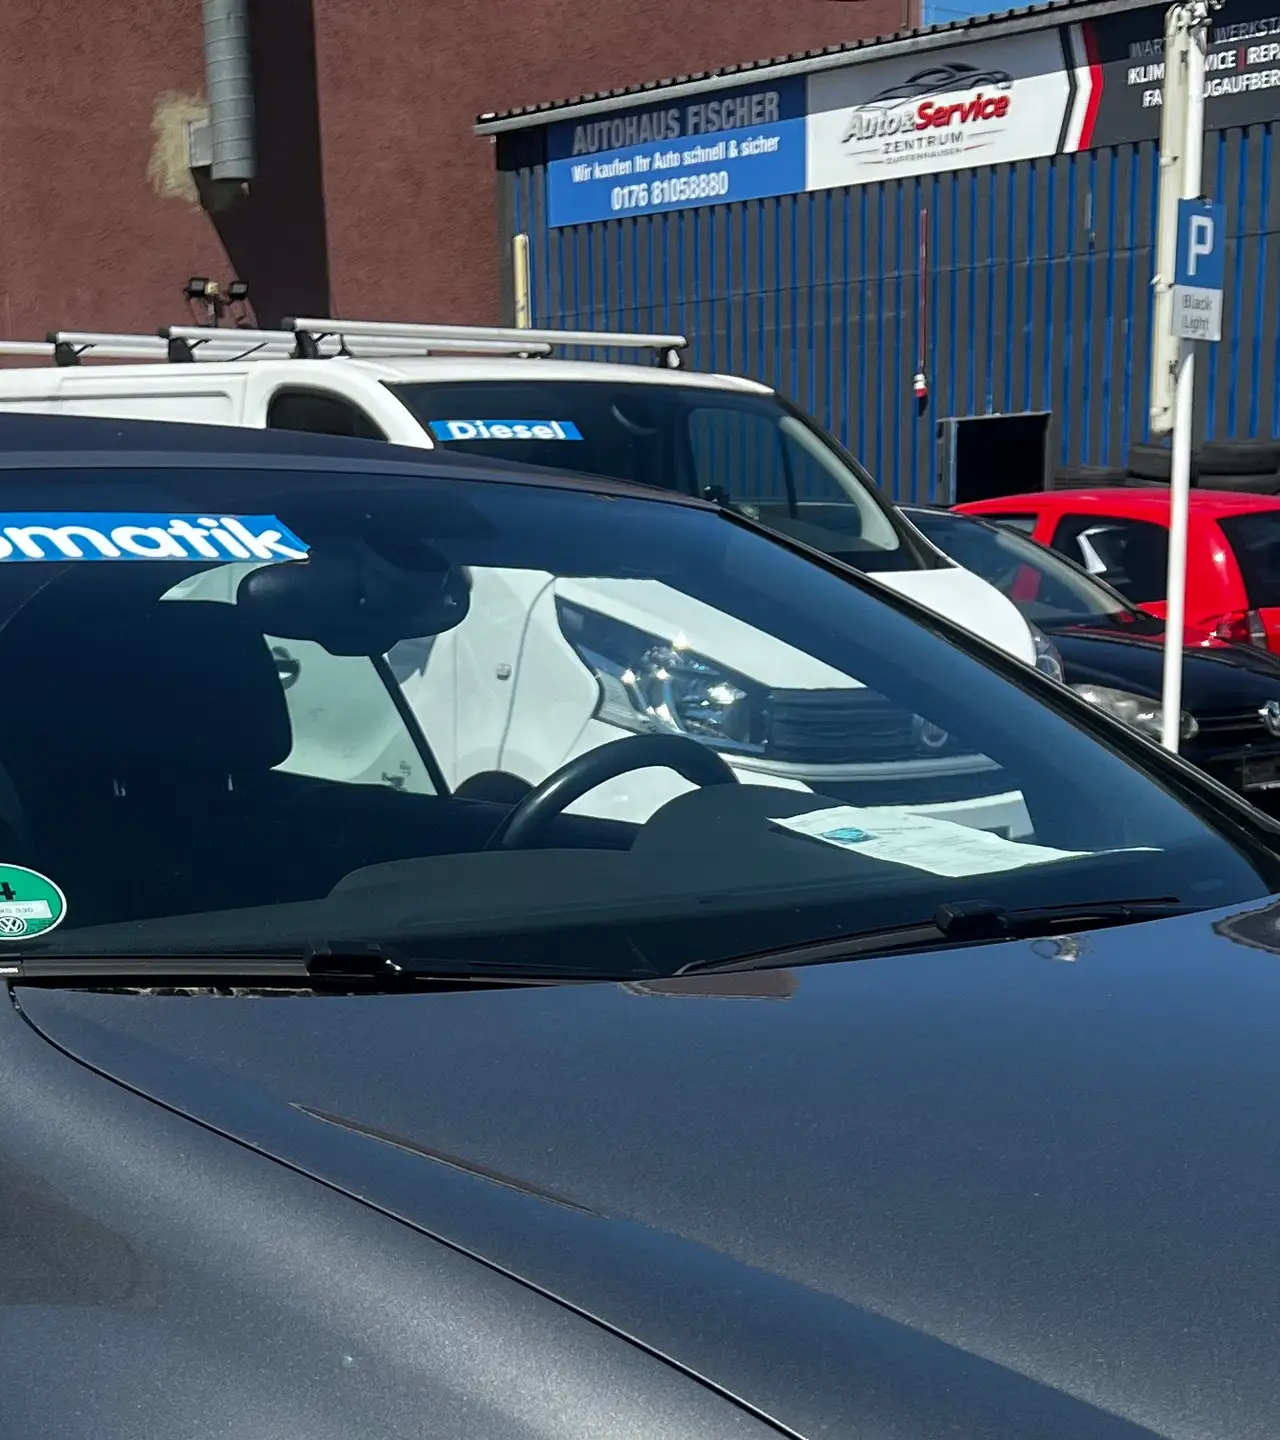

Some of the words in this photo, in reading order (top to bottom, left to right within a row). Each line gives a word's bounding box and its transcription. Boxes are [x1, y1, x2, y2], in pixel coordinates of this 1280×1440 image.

[572, 107, 681, 155] AUTOHAUS
[685, 91, 780, 136] FISCHER
[571, 164, 592, 182] Wir
[593, 158, 632, 179] kaufen
[634, 154, 651, 173] Ihr
[652, 150, 681, 171] Auto
[682, 141, 726, 165] schnell
[728, 139, 738, 158] &
[740, 135, 781, 156] sicher
[883, 131, 964, 155] ZENTRUM
[610, 182, 649, 211] 0176
[651, 171, 729, 205] 81058880
[1186, 214, 1214, 276] P
[1183, 294, 1212, 311] Black
[1183, 315, 1209, 333] Light
[446, 420, 567, 440] Diesel
